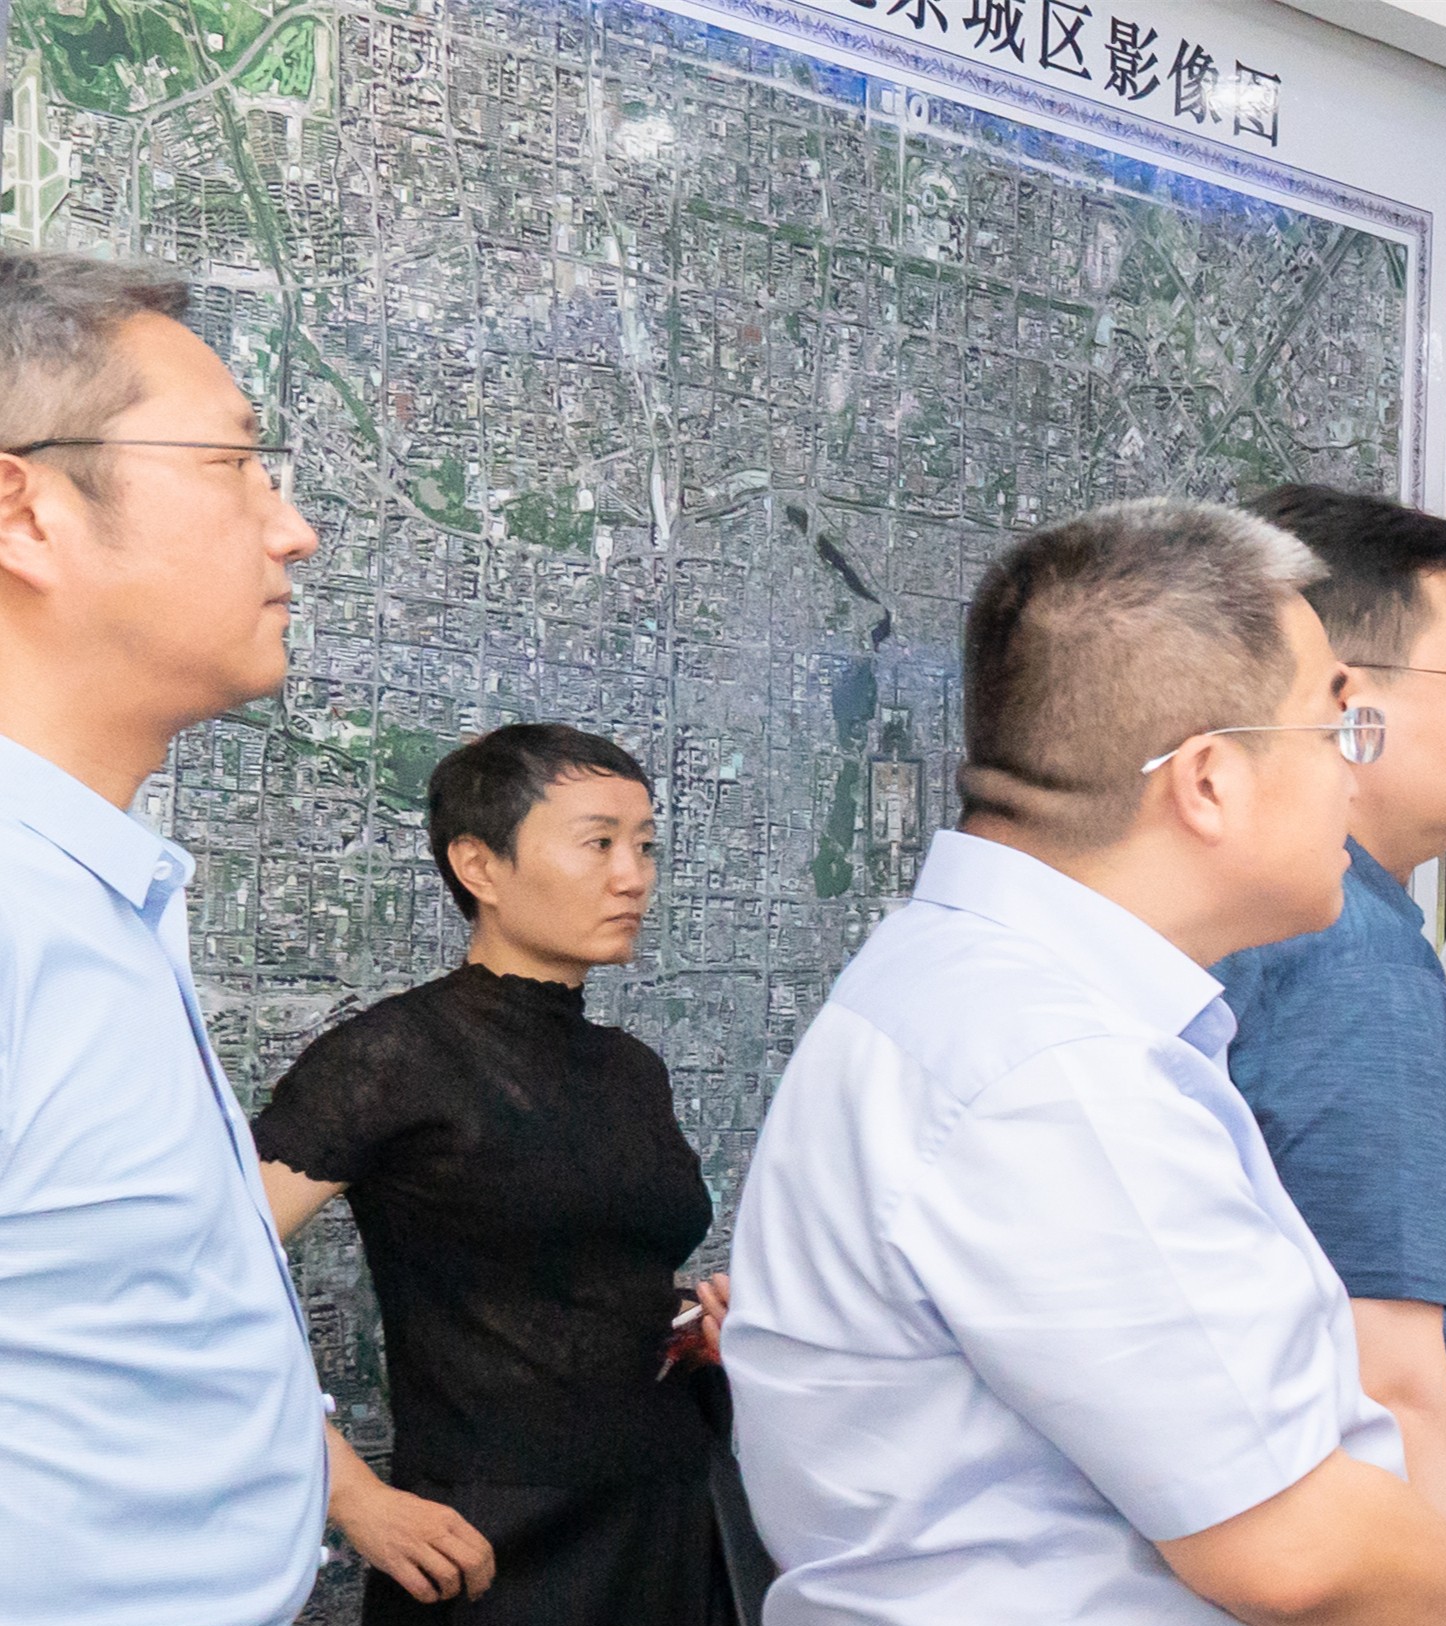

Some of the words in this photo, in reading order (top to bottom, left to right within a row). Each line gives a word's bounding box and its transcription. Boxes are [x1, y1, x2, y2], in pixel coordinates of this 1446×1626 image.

[850, 0, 1282, 148] 城区影像图
